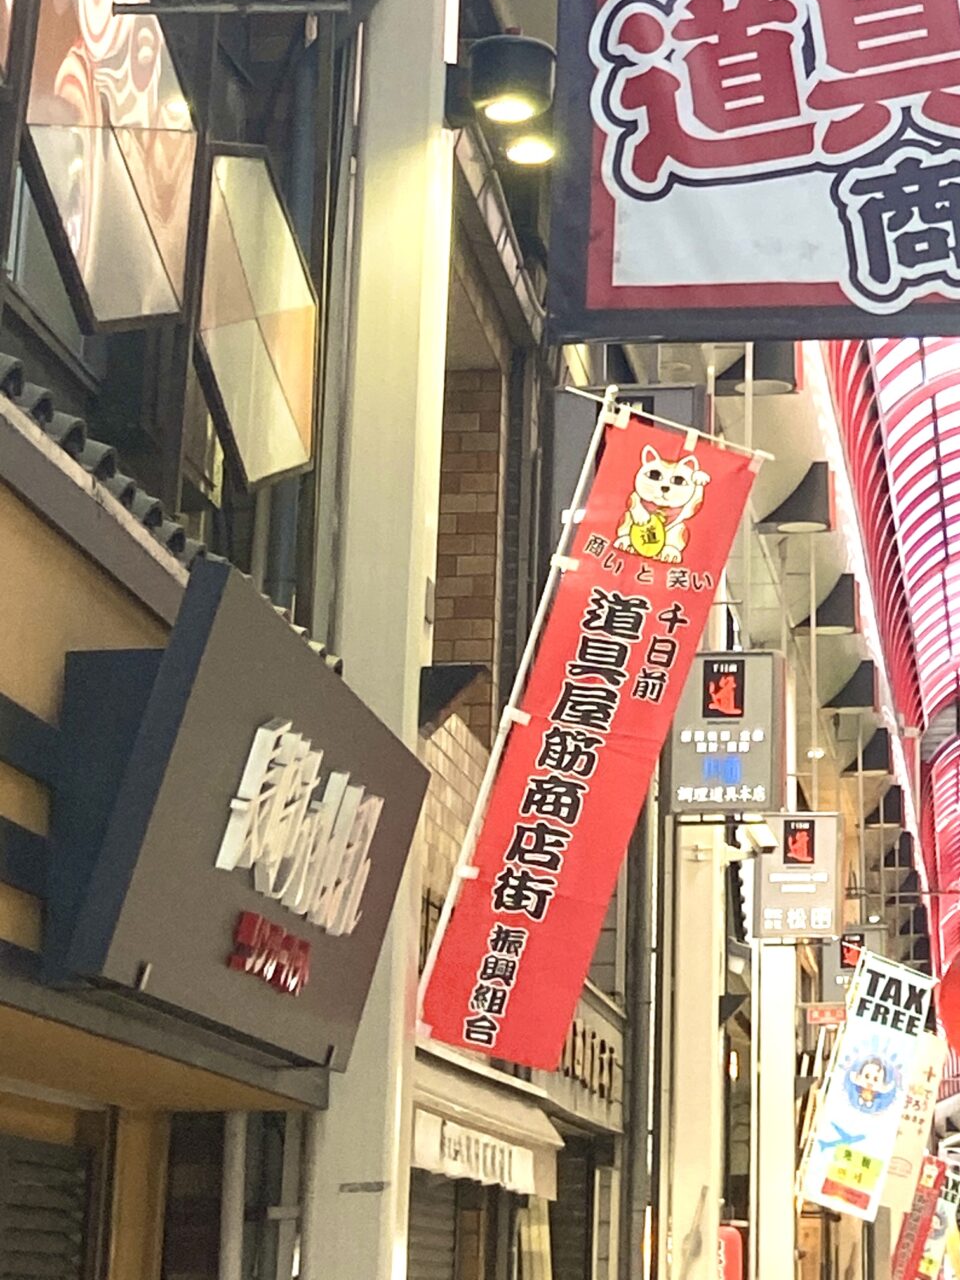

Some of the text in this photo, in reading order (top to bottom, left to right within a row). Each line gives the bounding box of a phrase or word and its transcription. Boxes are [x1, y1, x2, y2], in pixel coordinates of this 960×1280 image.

[633, 602, 691, 703] 千日前
[493, 588, 652, 922] 道具屋筋商店街
[462, 924, 528, 1046] 振興組合
[856, 996, 921, 1037] FREE
[866, 968, 928, 1016] TAX
